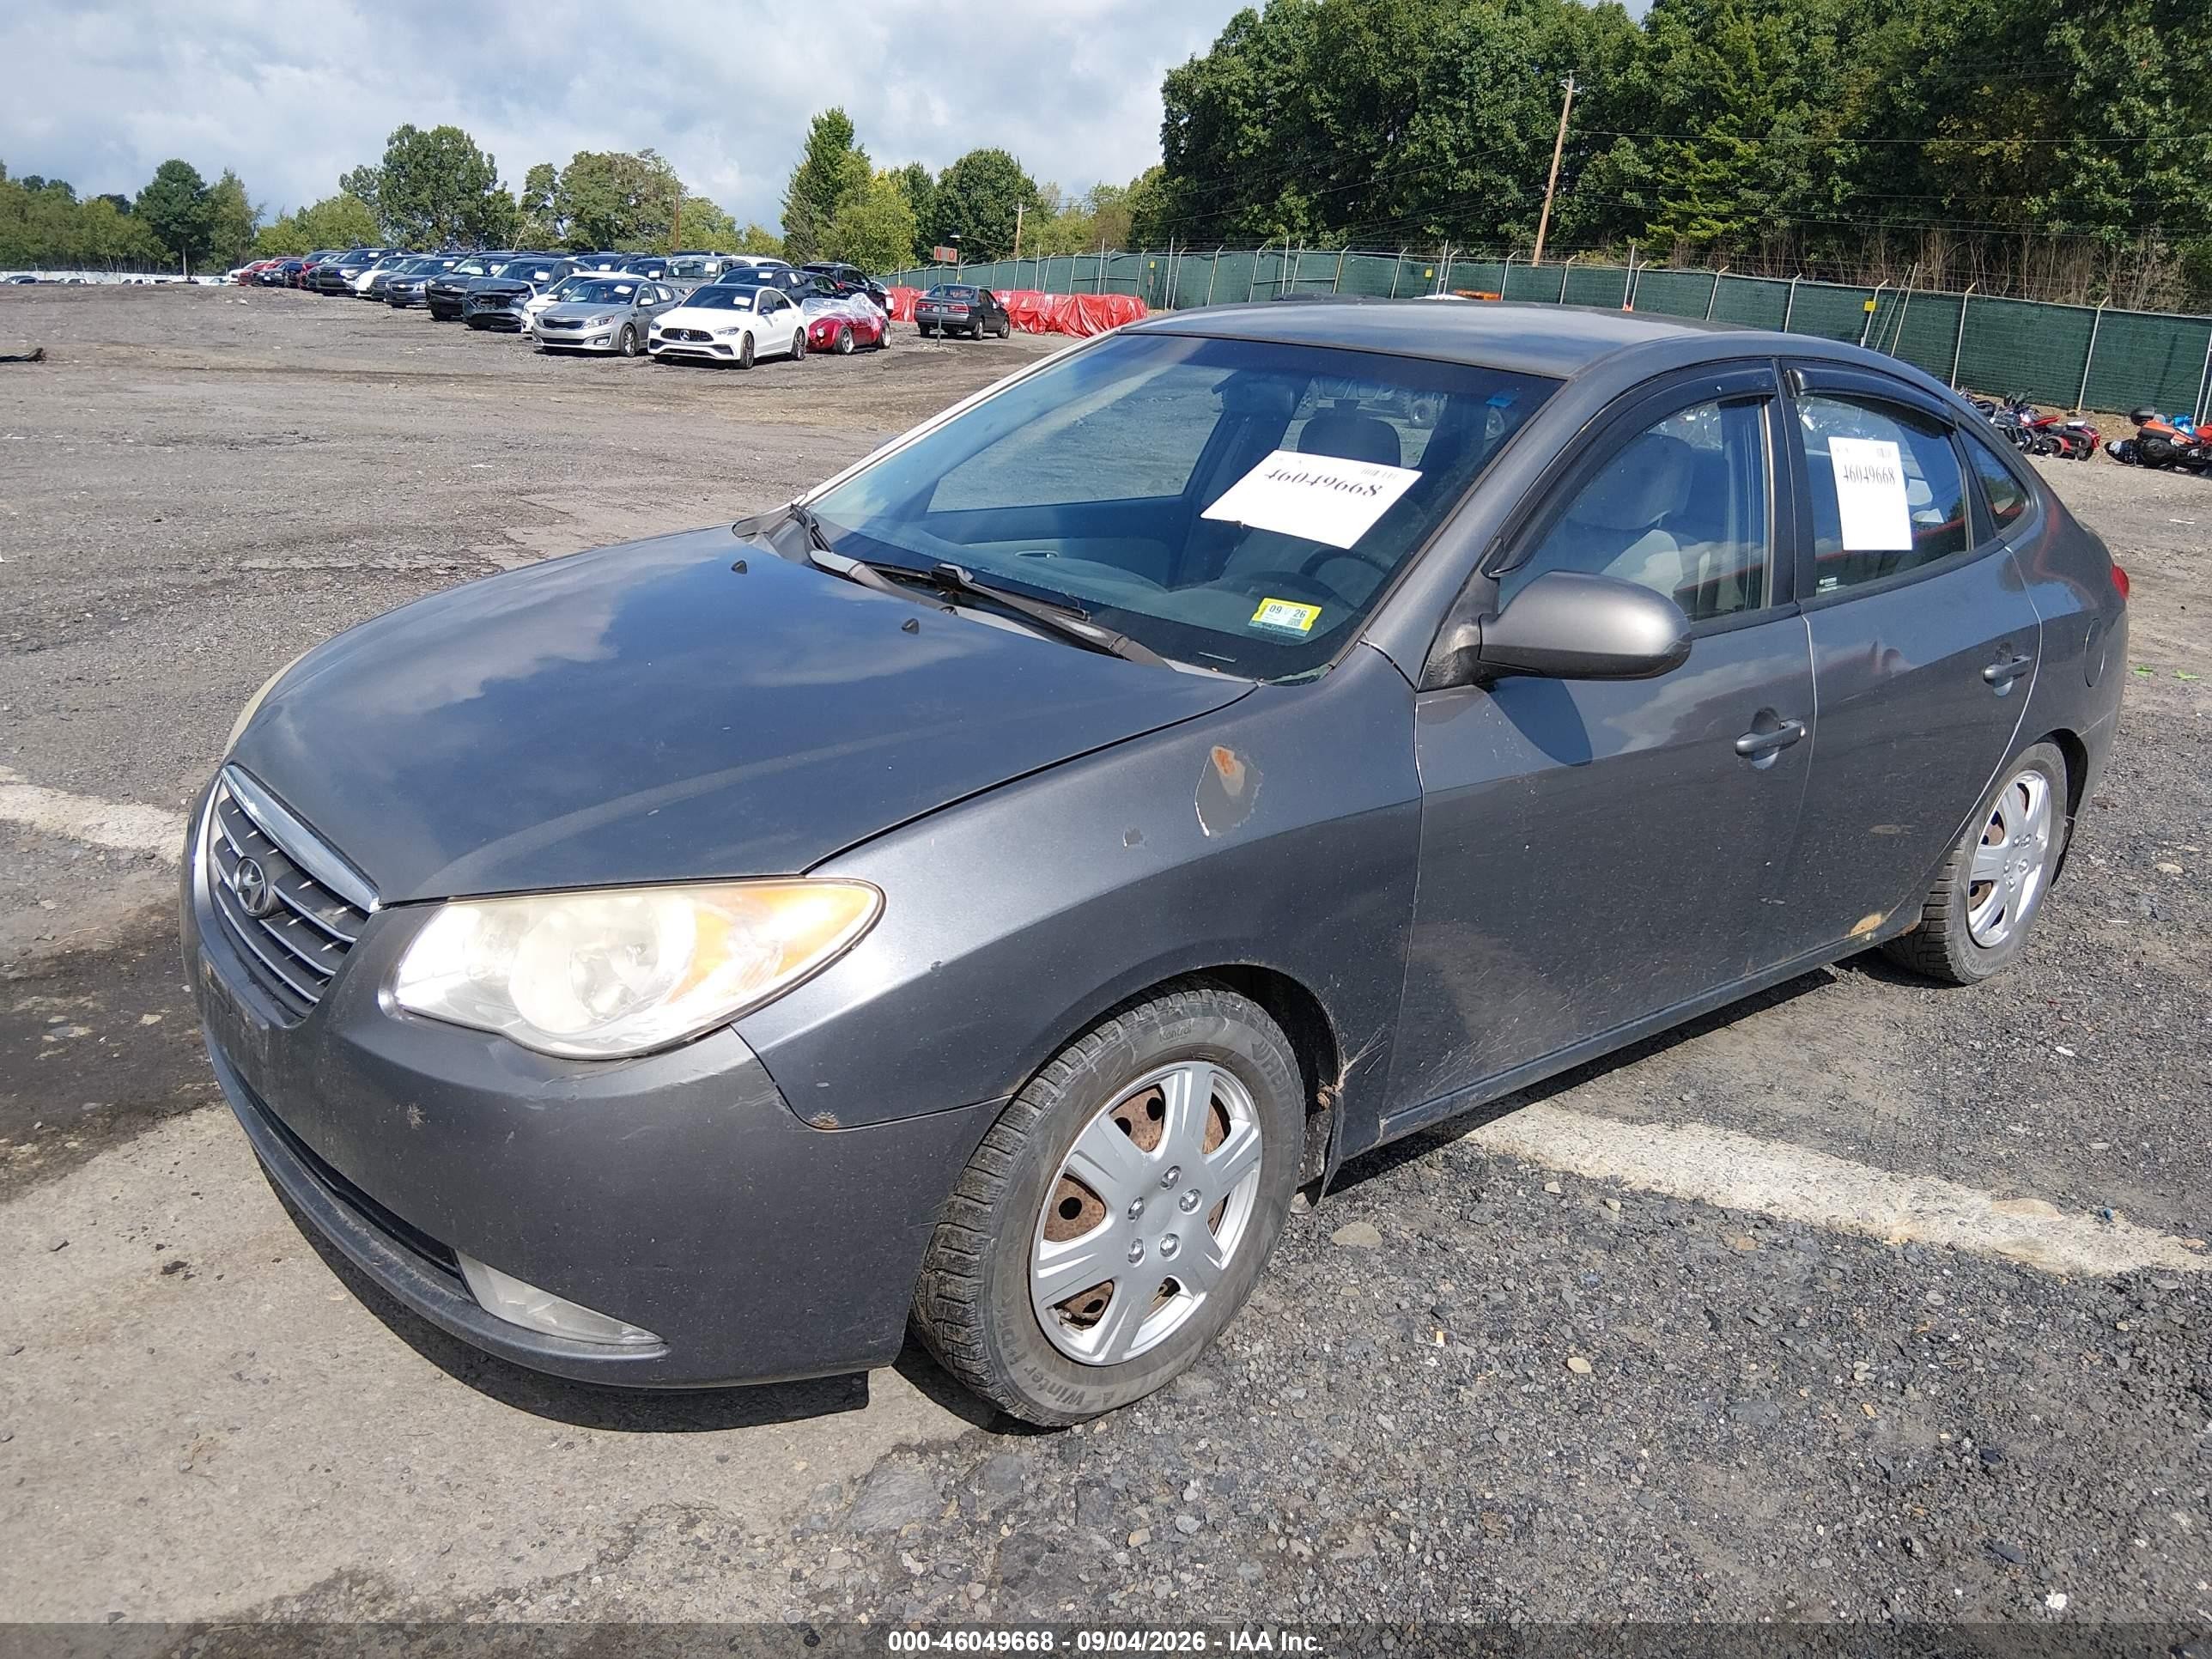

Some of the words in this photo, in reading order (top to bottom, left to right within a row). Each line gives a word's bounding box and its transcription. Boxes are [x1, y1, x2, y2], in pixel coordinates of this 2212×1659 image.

[1264, 468, 1382, 497] 46049668
[1843, 464, 1896, 486] 46049668
[1269, 605, 1283, 614] 09
[1293, 609, 1307, 618] 26
[1024, 1365, 1086, 1407] Winter
